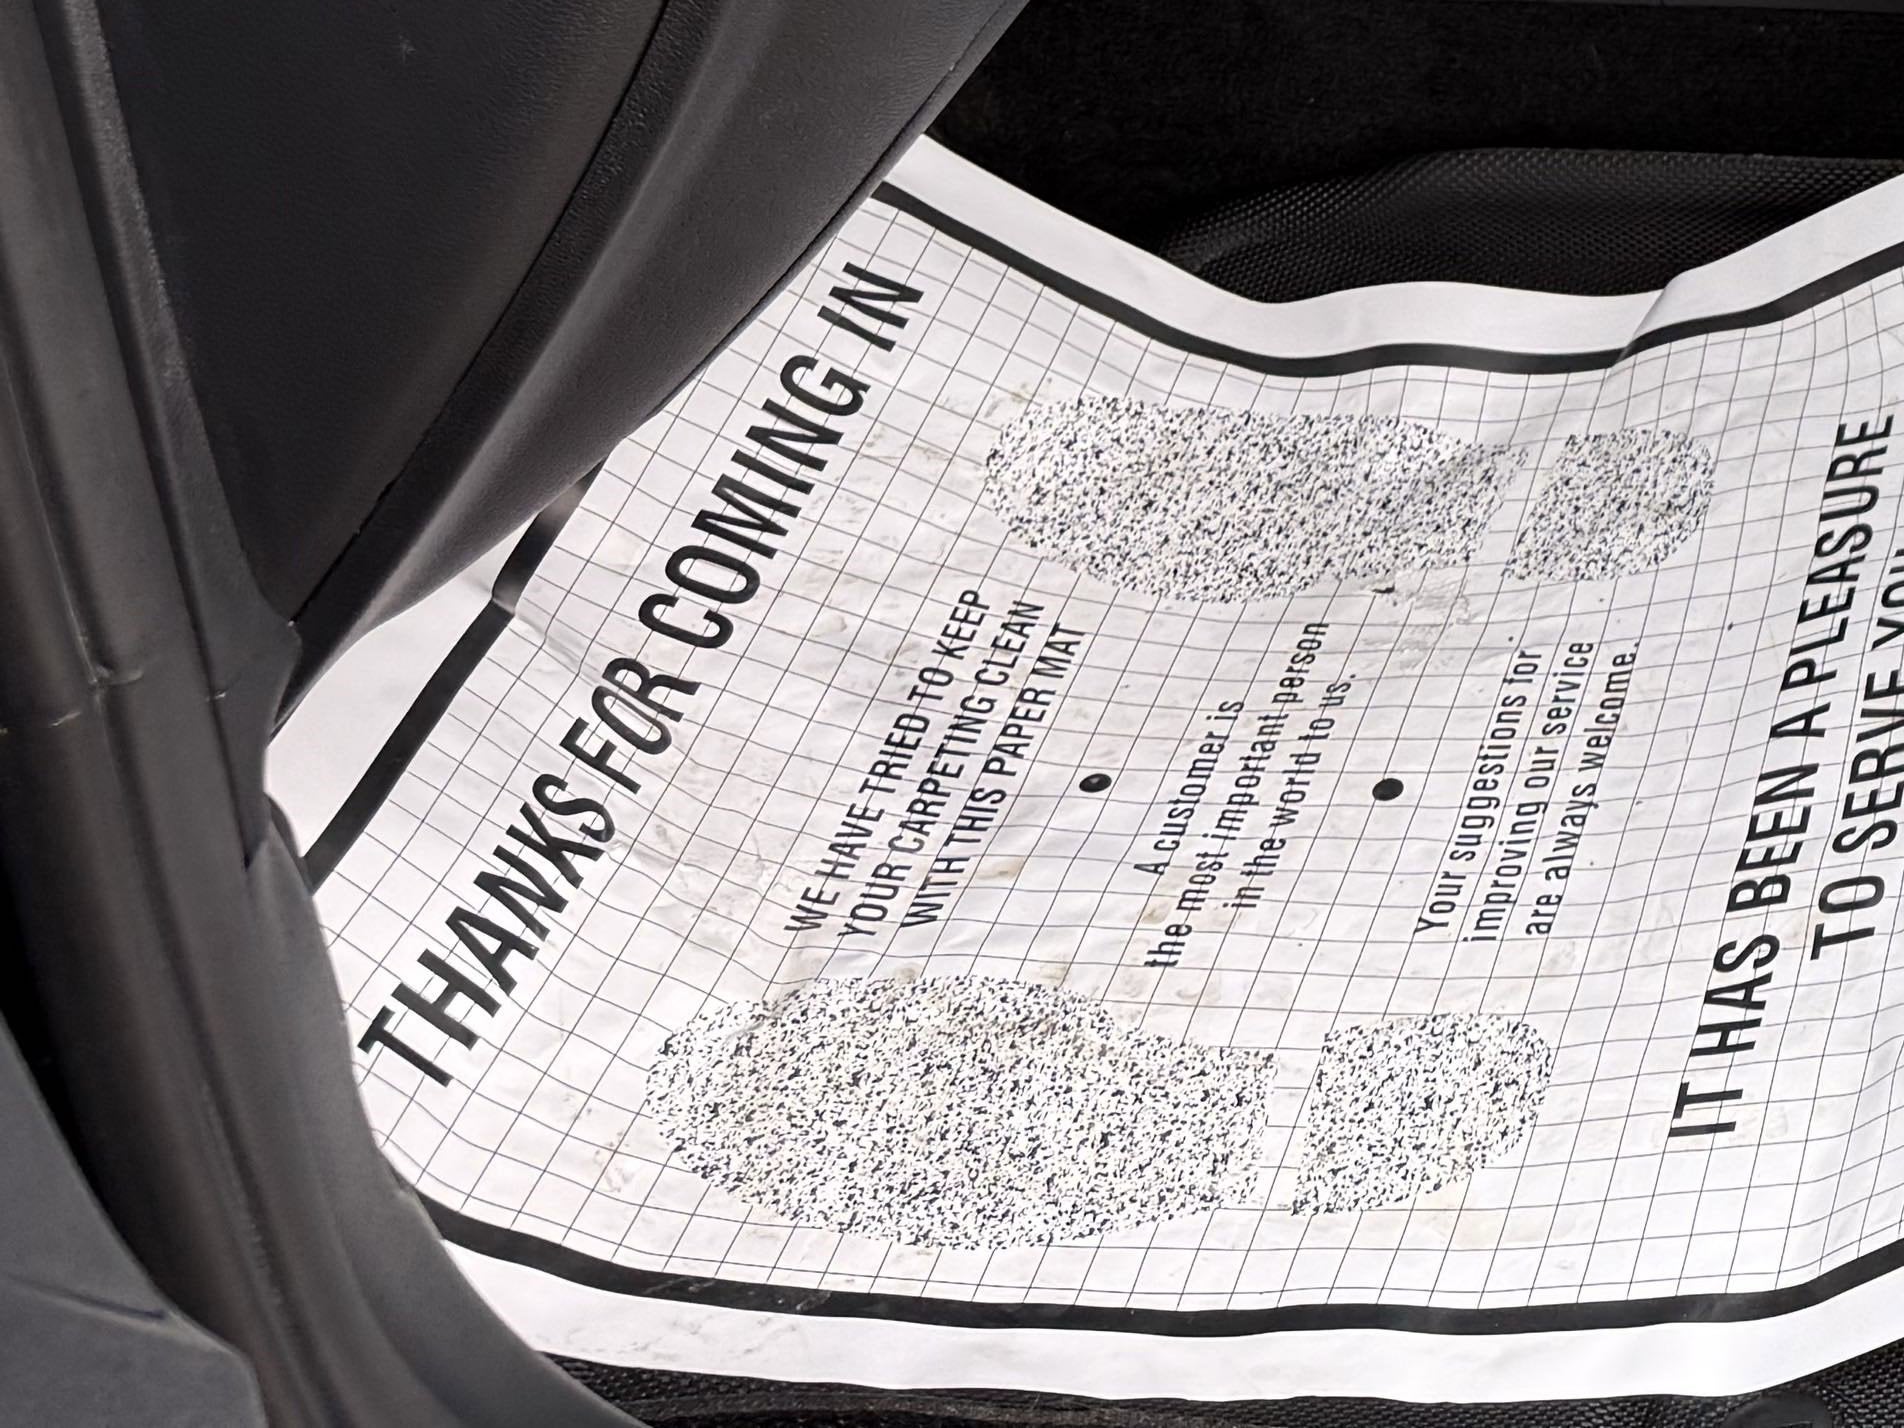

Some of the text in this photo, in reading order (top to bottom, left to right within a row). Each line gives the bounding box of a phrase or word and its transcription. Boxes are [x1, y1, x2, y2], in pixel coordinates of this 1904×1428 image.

[358, 260, 926, 1088] THANKS FOR COMING IN
[783, 588, 991, 935] WE HAVE TRIED TO KEEP
[836, 599, 1046, 939] YOUR CARPETING CLEAN
[899, 622, 1087, 929] WITH THIS PAPER MAT
[1133, 700, 1245, 876] A customer is
[1144, 621, 1330, 968] the most important person
[1222, 674, 1357, 909] in the world to us.
[1413, 648, 1543, 934] Your suggestions for
[1462, 641, 1595, 942] improving our service
[1524, 641, 1640, 936] are always welcome.
[1667, 413, 1897, 1142] IT HAS BEEN A PLEASURE
[1808, 874, 1887, 962] TO
